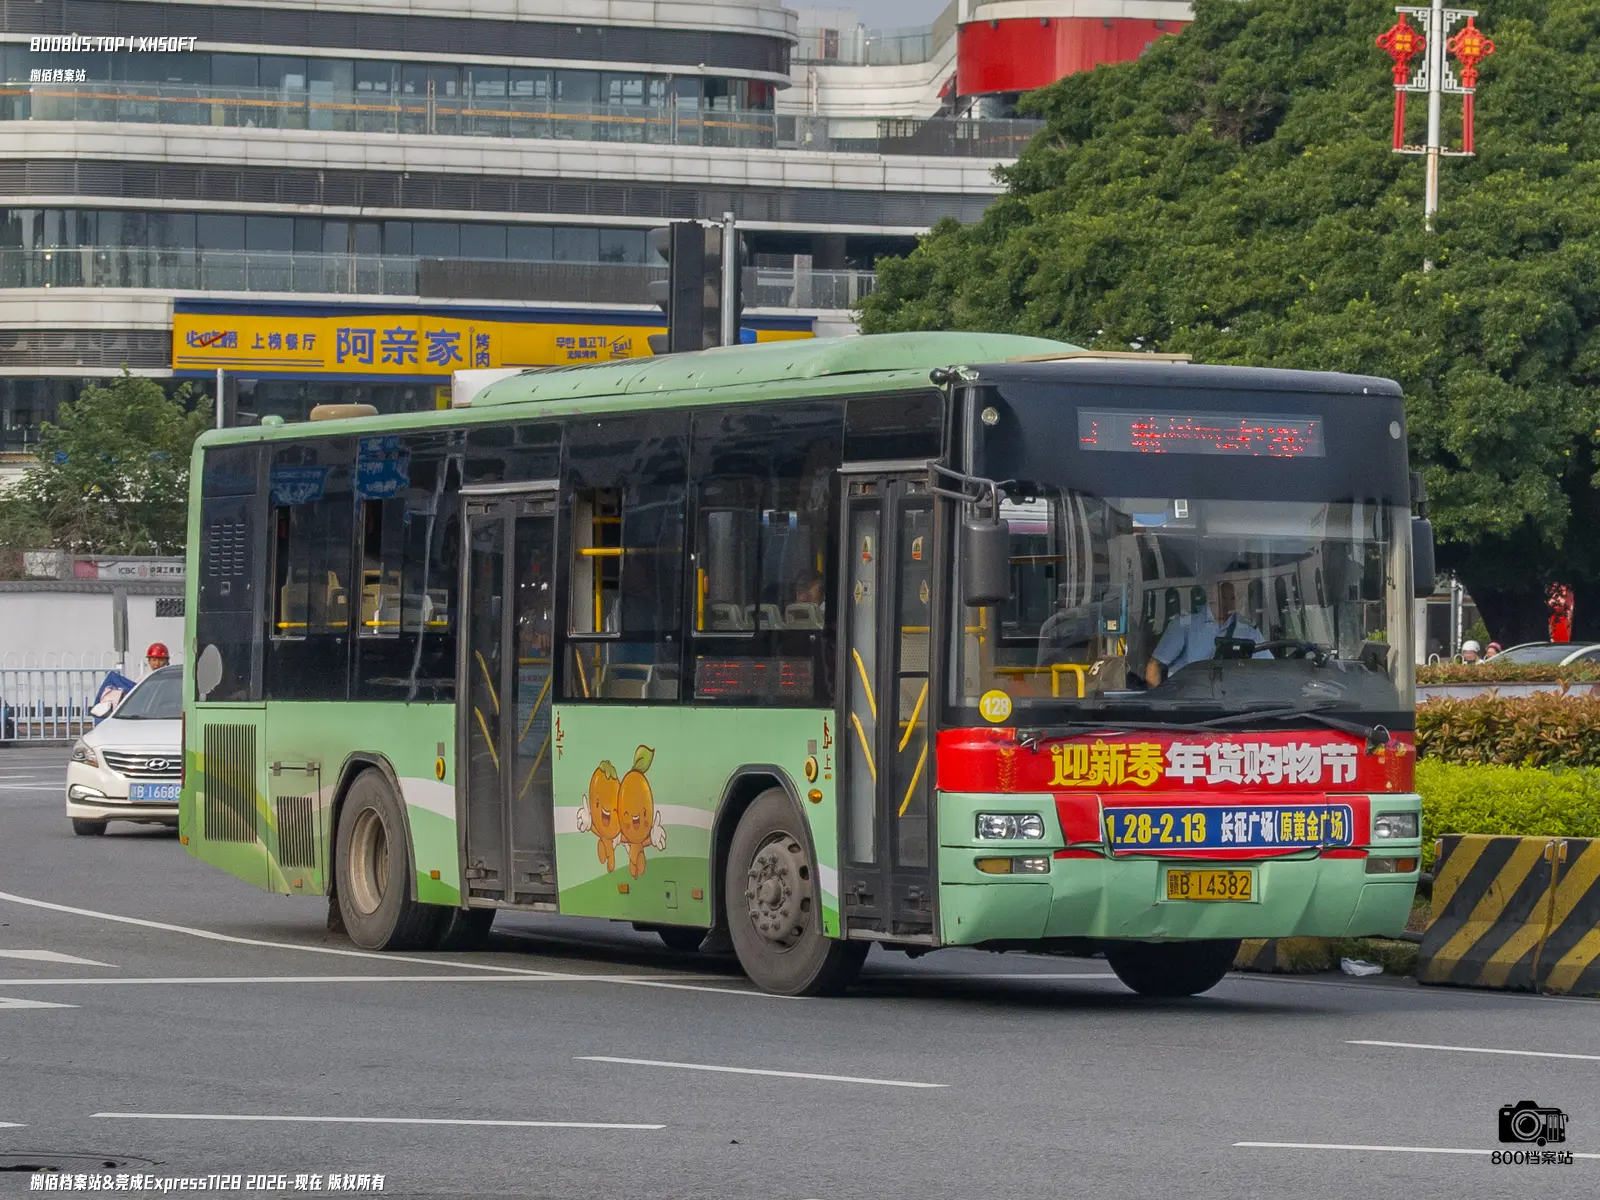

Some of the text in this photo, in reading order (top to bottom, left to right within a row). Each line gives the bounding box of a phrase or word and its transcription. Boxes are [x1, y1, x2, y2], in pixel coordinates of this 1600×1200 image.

[251, 332, 316, 350] 上榜餐厅
[336, 326, 463, 366] 阿亲家
[475, 334, 491, 368] 烤肉
[984, 697, 1009, 716] 128
[556, 745, 563, 760] 下
[824, 754, 831, 769] 上
[1048, 739, 1358, 787] 迎新春 年货购物节
[1105, 813, 1206, 844] 1.28-2.13
